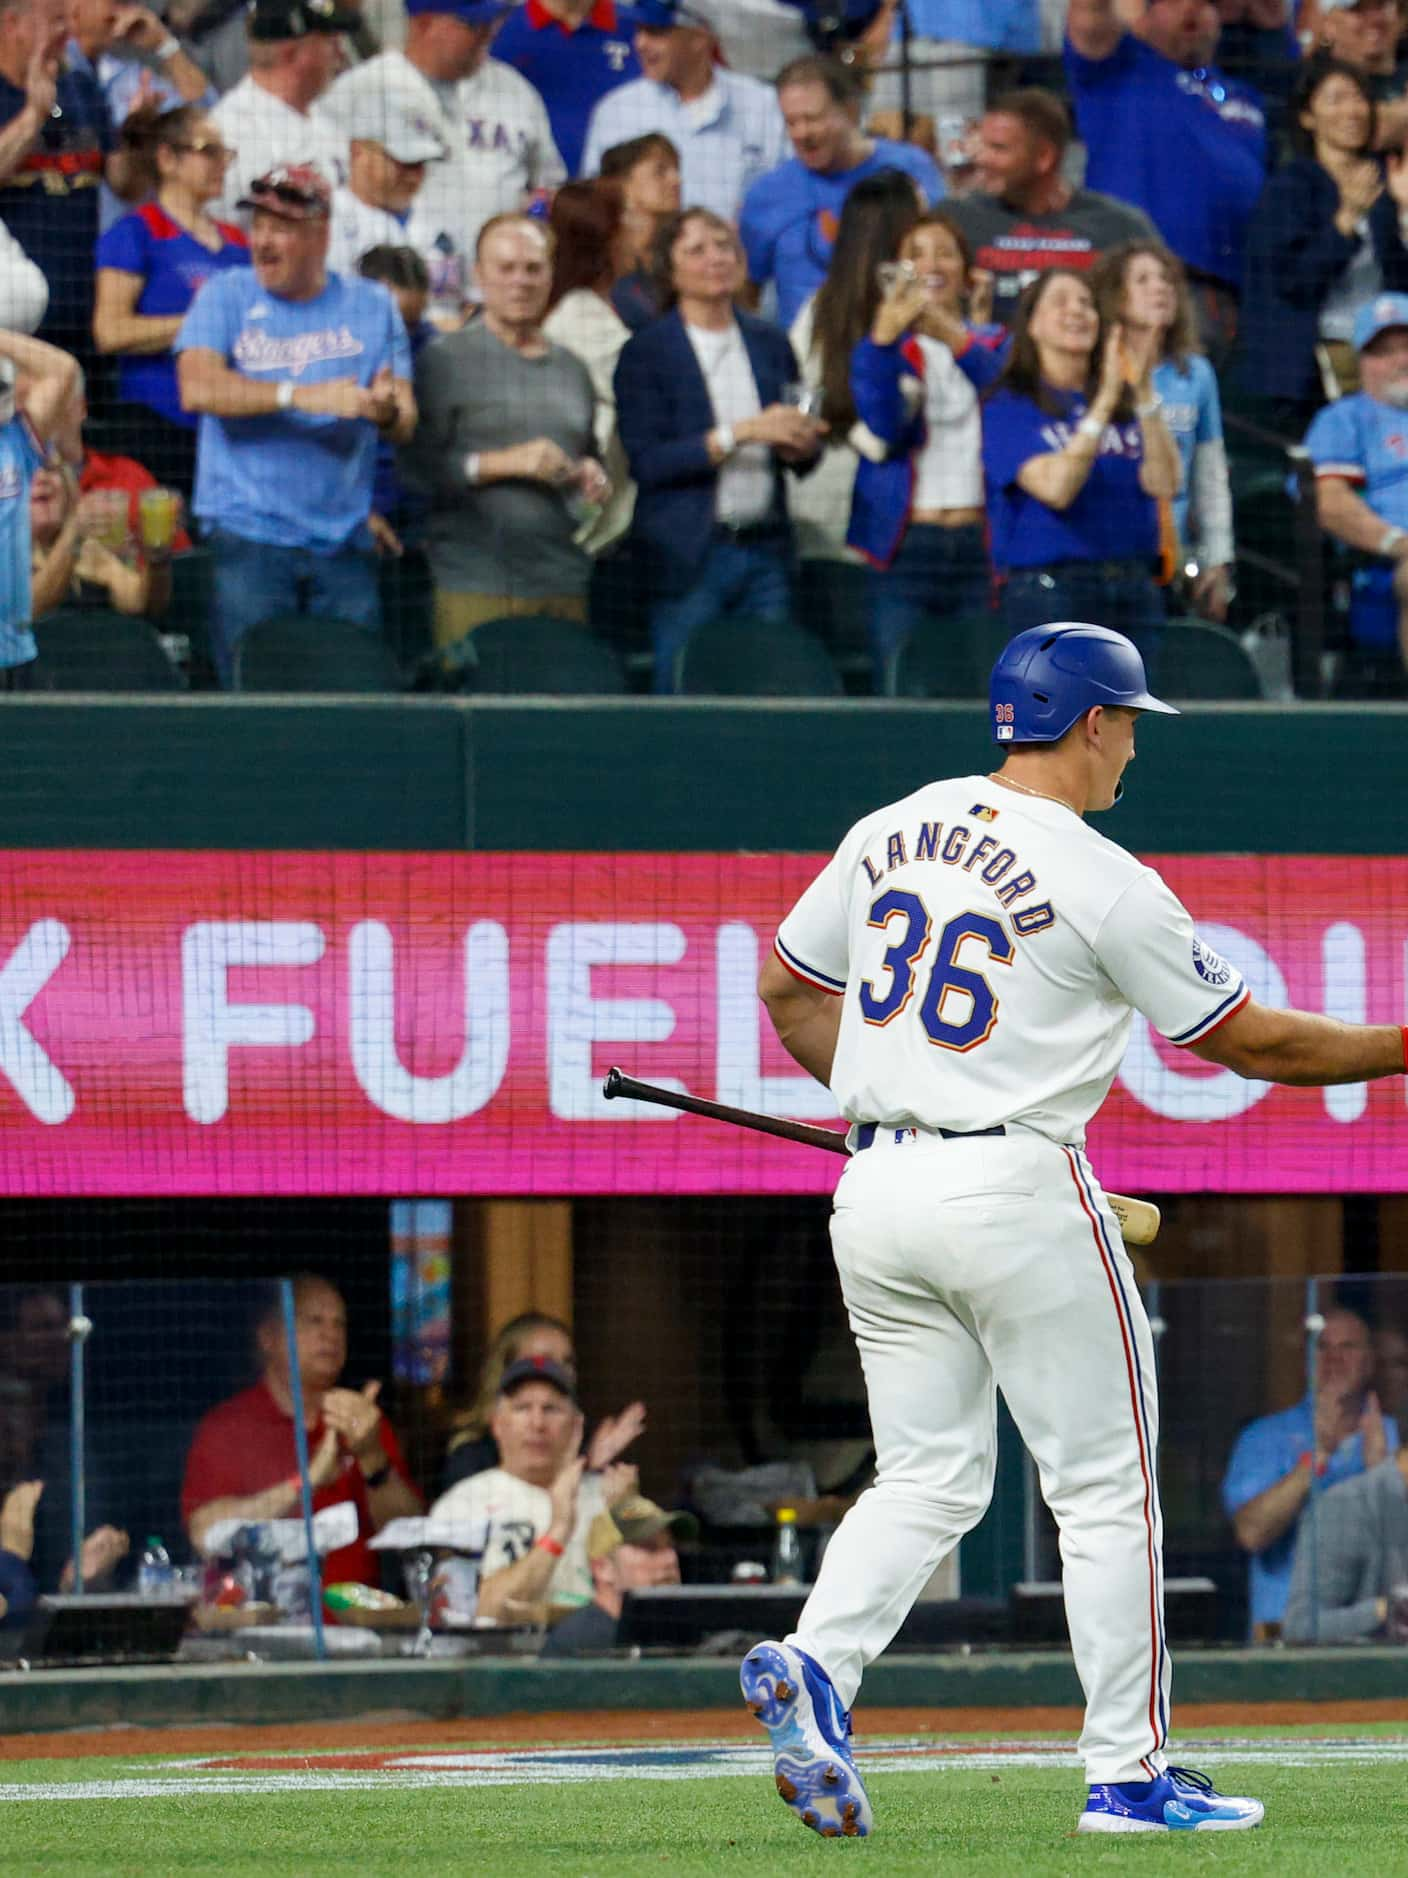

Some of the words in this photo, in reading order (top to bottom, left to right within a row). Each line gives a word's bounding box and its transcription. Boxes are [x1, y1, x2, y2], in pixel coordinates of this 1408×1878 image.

[996, 703, 1015, 723] 36
[862, 822, 1057, 937] LANGFORD
[182, 917, 843, 1125] FUEL
[859, 886, 1016, 1053] 36
